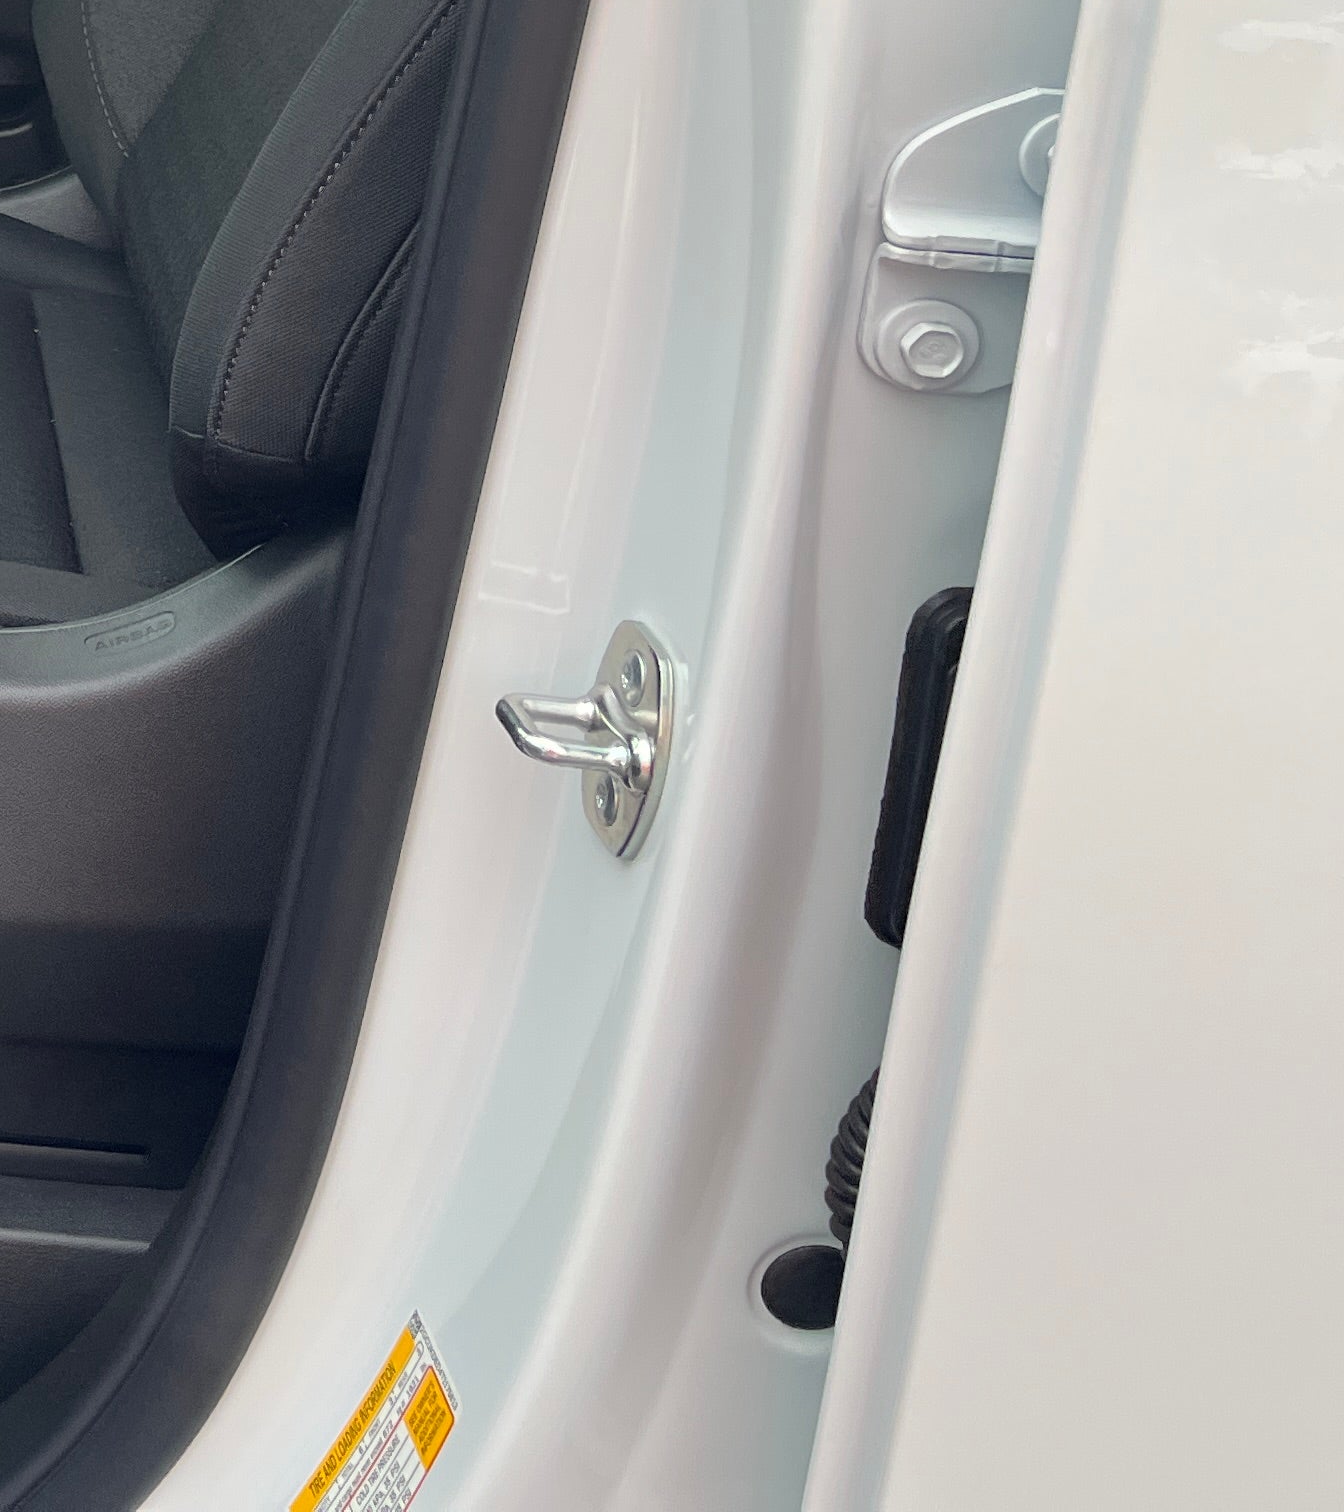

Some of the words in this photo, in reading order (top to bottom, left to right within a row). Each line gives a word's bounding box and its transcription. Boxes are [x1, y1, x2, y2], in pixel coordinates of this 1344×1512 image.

[308, 1473, 326, 1498] TIRE
[321, 1456, 338, 1481] AND
[336, 1417, 362, 1462] LOADING
[358, 1361, 396, 1425] INFORMATION
[356, 1484, 370, 1505] COLD
